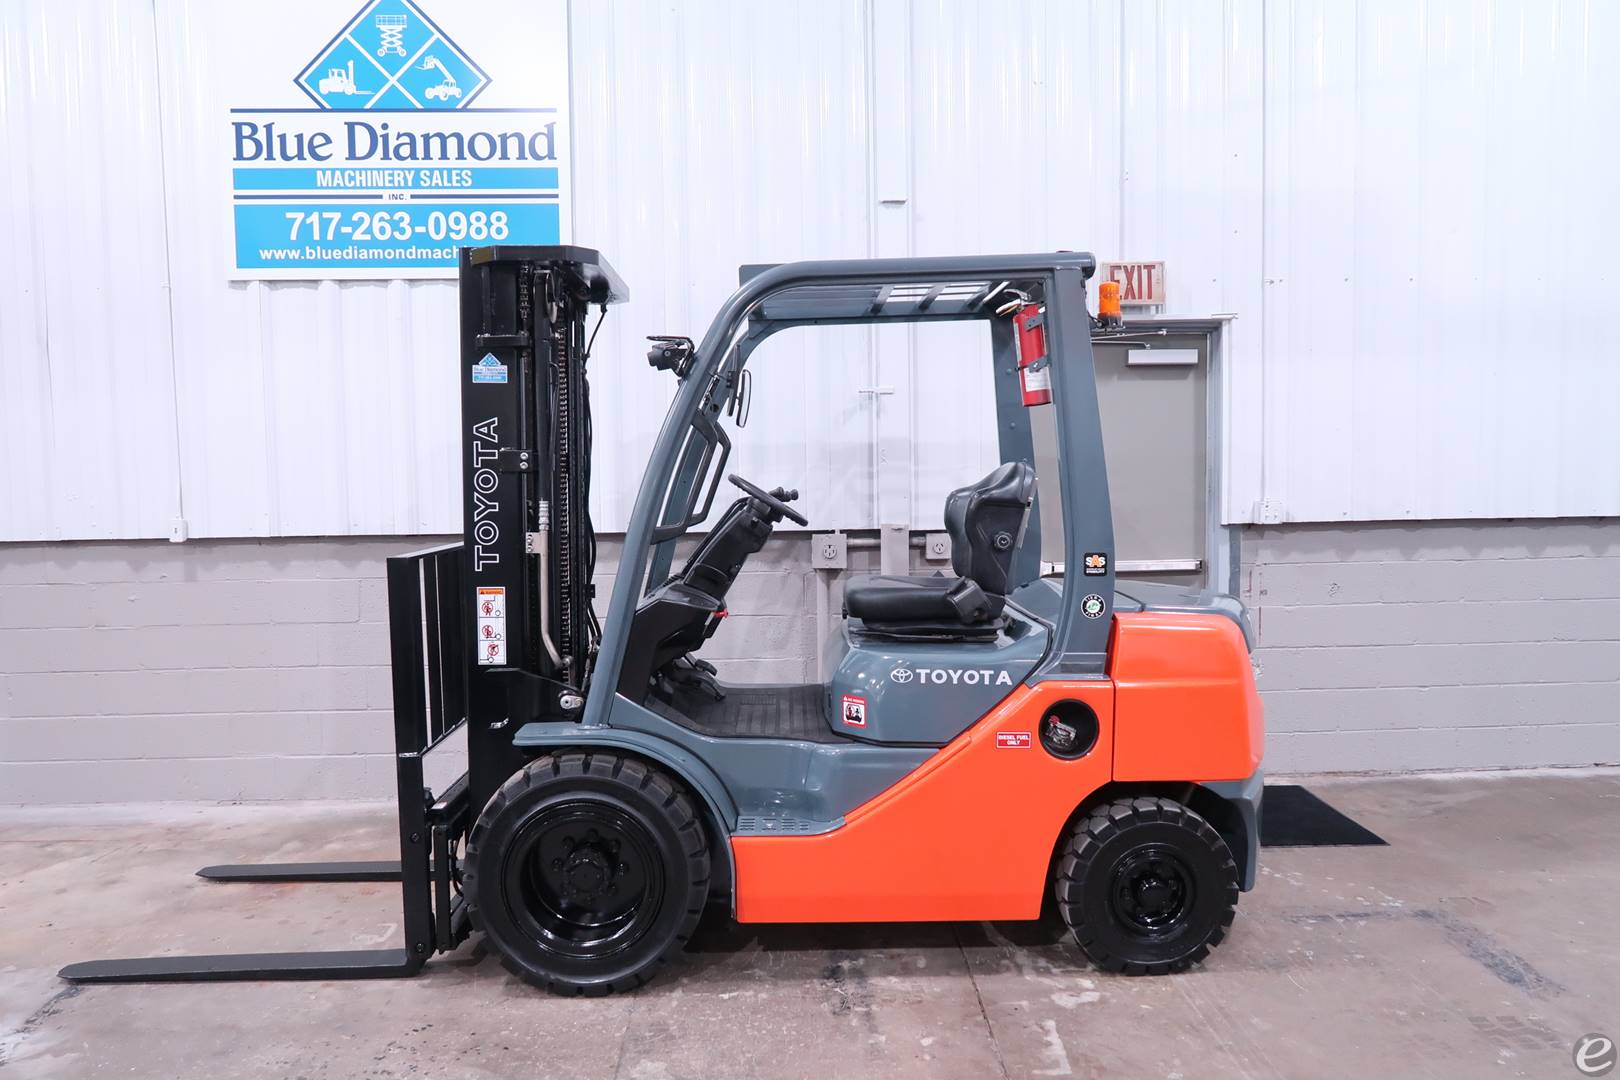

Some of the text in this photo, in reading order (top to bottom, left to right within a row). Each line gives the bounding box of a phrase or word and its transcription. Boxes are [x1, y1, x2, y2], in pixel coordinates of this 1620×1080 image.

[231, 121, 557, 161] Blue Diamond
[316, 169, 473, 187] MACHINERY SALES
[285, 211, 509, 241] 717-263-0988
[259, 245, 460, 260] www.bluediamondmach
[473, 416, 500, 572] TOYOTA
[916, 668, 1013, 686] TOYOTA
